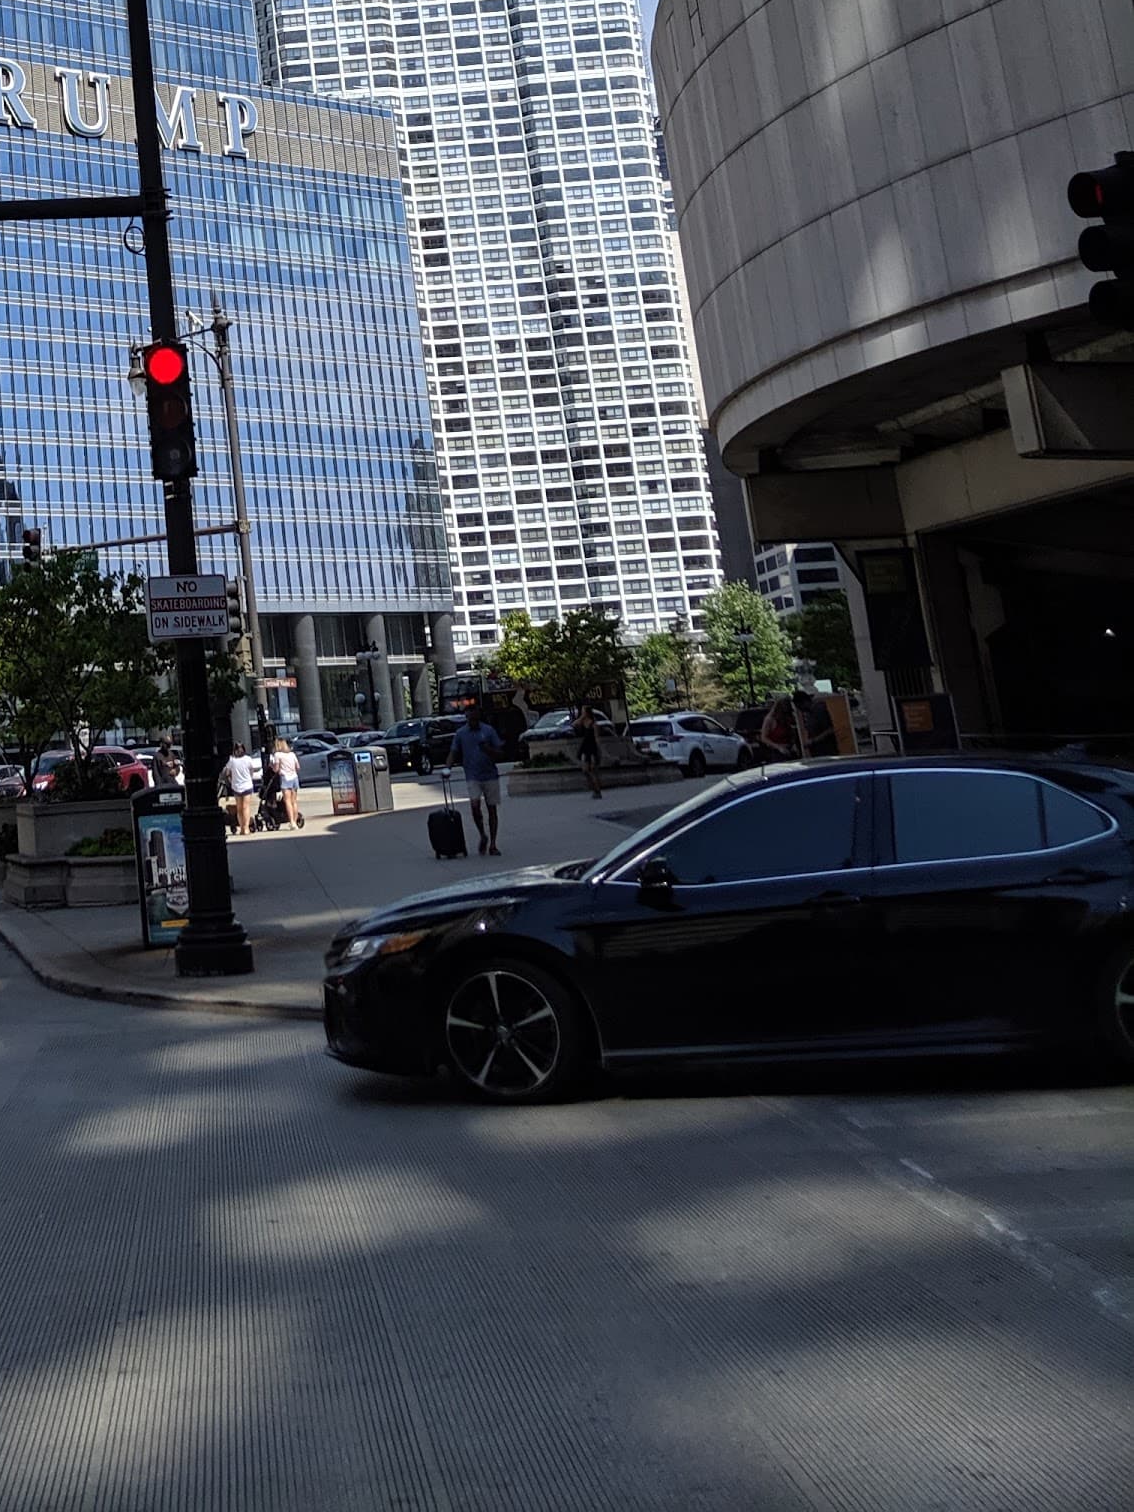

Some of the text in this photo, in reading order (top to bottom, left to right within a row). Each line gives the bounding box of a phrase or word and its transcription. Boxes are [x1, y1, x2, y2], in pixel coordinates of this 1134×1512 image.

[177, 581, 197, 592] NO
[150, 597, 226, 611] SKATEBOARDING
[154, 615, 225, 629] ON SIDEWALK
